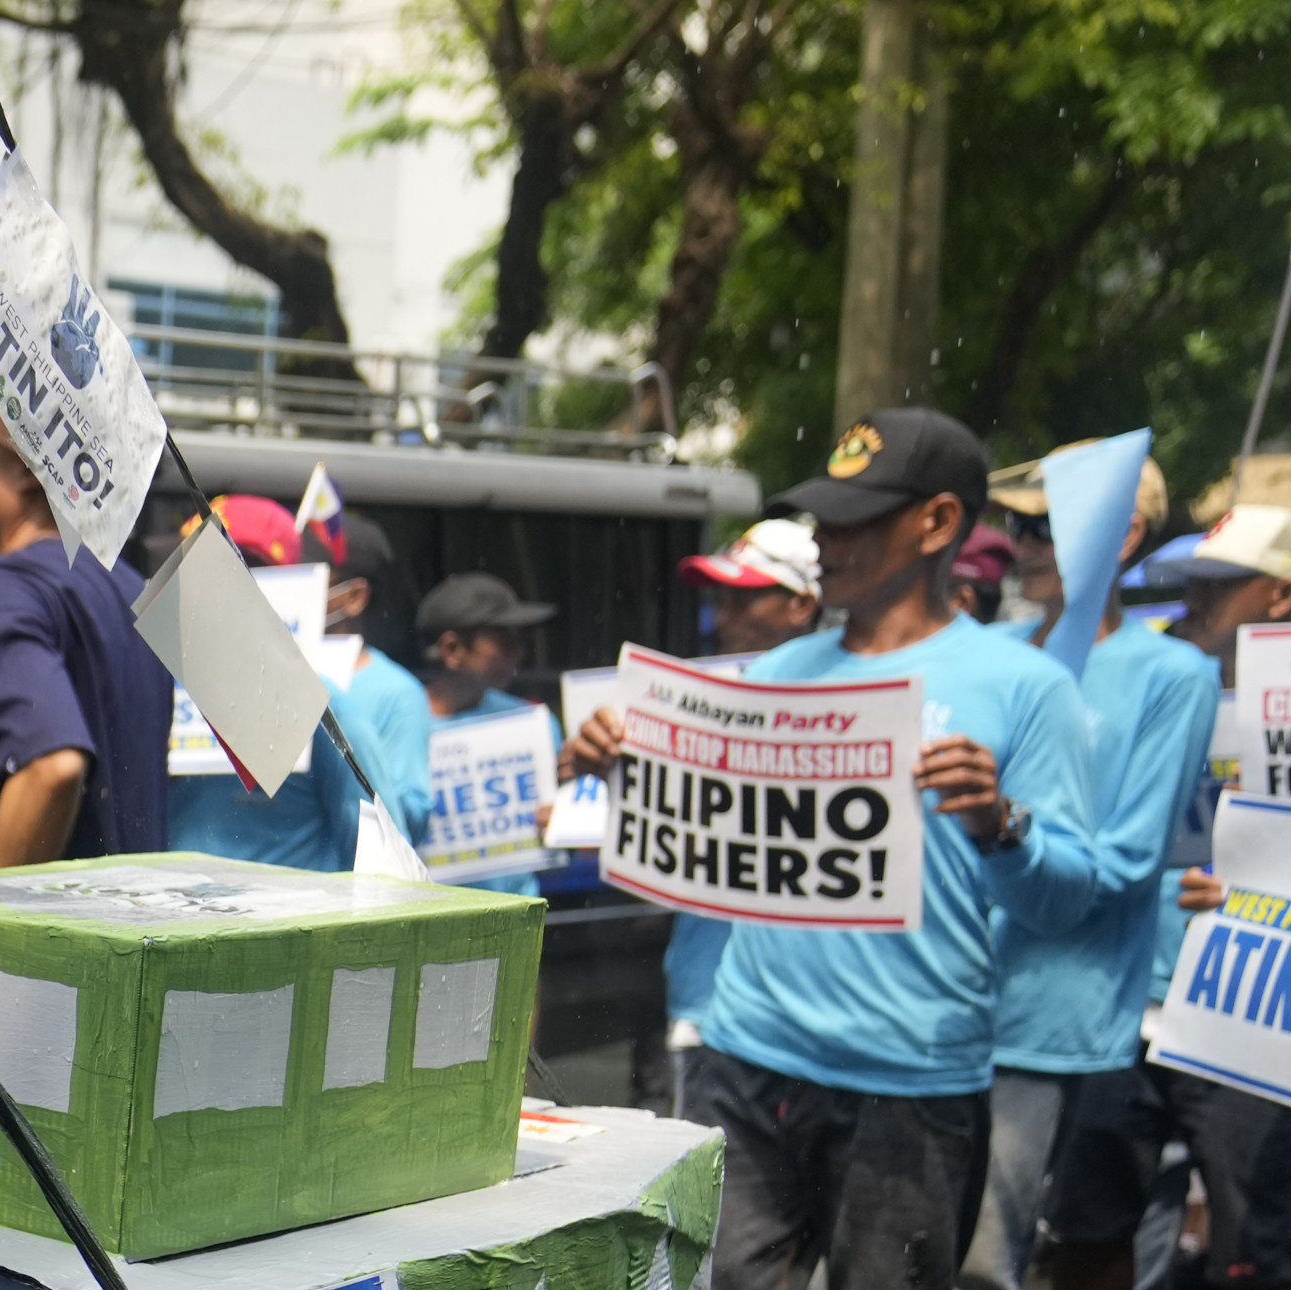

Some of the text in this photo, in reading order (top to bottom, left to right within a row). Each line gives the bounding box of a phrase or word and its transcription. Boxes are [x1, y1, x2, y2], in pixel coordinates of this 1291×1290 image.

[27, 341, 92, 436] PHILIPPINE
[89, 435, 114, 474] SEA
[41, 454, 64, 487] SCAP
[44, 407, 115, 511] ITO!
[677, 692, 859, 734] Akbayan Party
[674, 727, 727, 767] STOP
[726, 739, 890, 777] HARASSING
[621, 752, 890, 841] FILIPINO
[617, 809, 888, 900] FISHERS!
[1222, 890, 1286, 925] WEST
